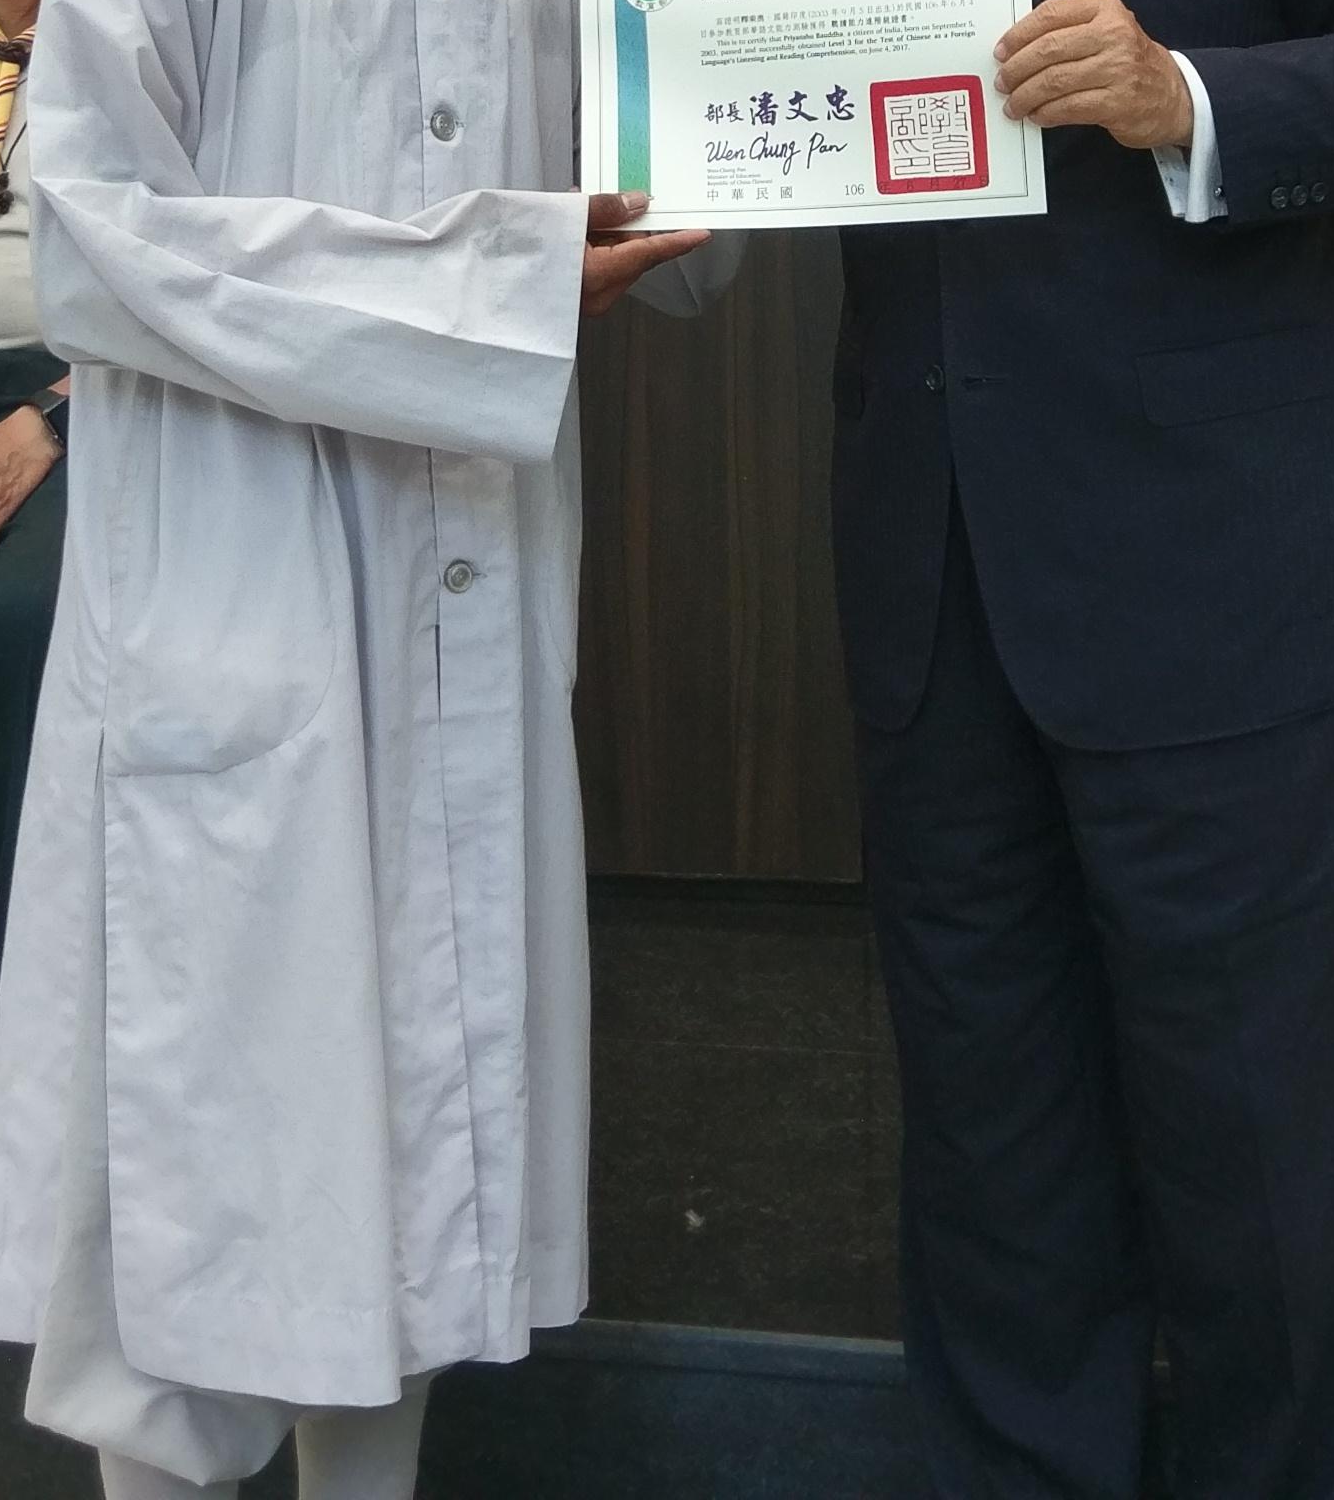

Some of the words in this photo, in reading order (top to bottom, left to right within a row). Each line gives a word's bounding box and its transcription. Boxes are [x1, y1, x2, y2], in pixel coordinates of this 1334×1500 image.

[747, 37, 767, 45] certify
[931, 21, 966, 31] September
[759, 43, 795, 53] successfully
[798, 41, 826, 50] obtained
[950, 30, 976, 39] Foreign
[779, 52, 805, 61] Reading
[892, 44, 910, 52] 2017.
[704, 101, 745, 125] 部長
[749, 84, 856, 126] 潘文忠
[705, 139, 747, 163] Wen
[749, 131, 802, 176] Chung
[806, 132, 848, 169] Pan
[707, 186, 793, 201] 中華民國
[845, 184, 865, 196] 106
